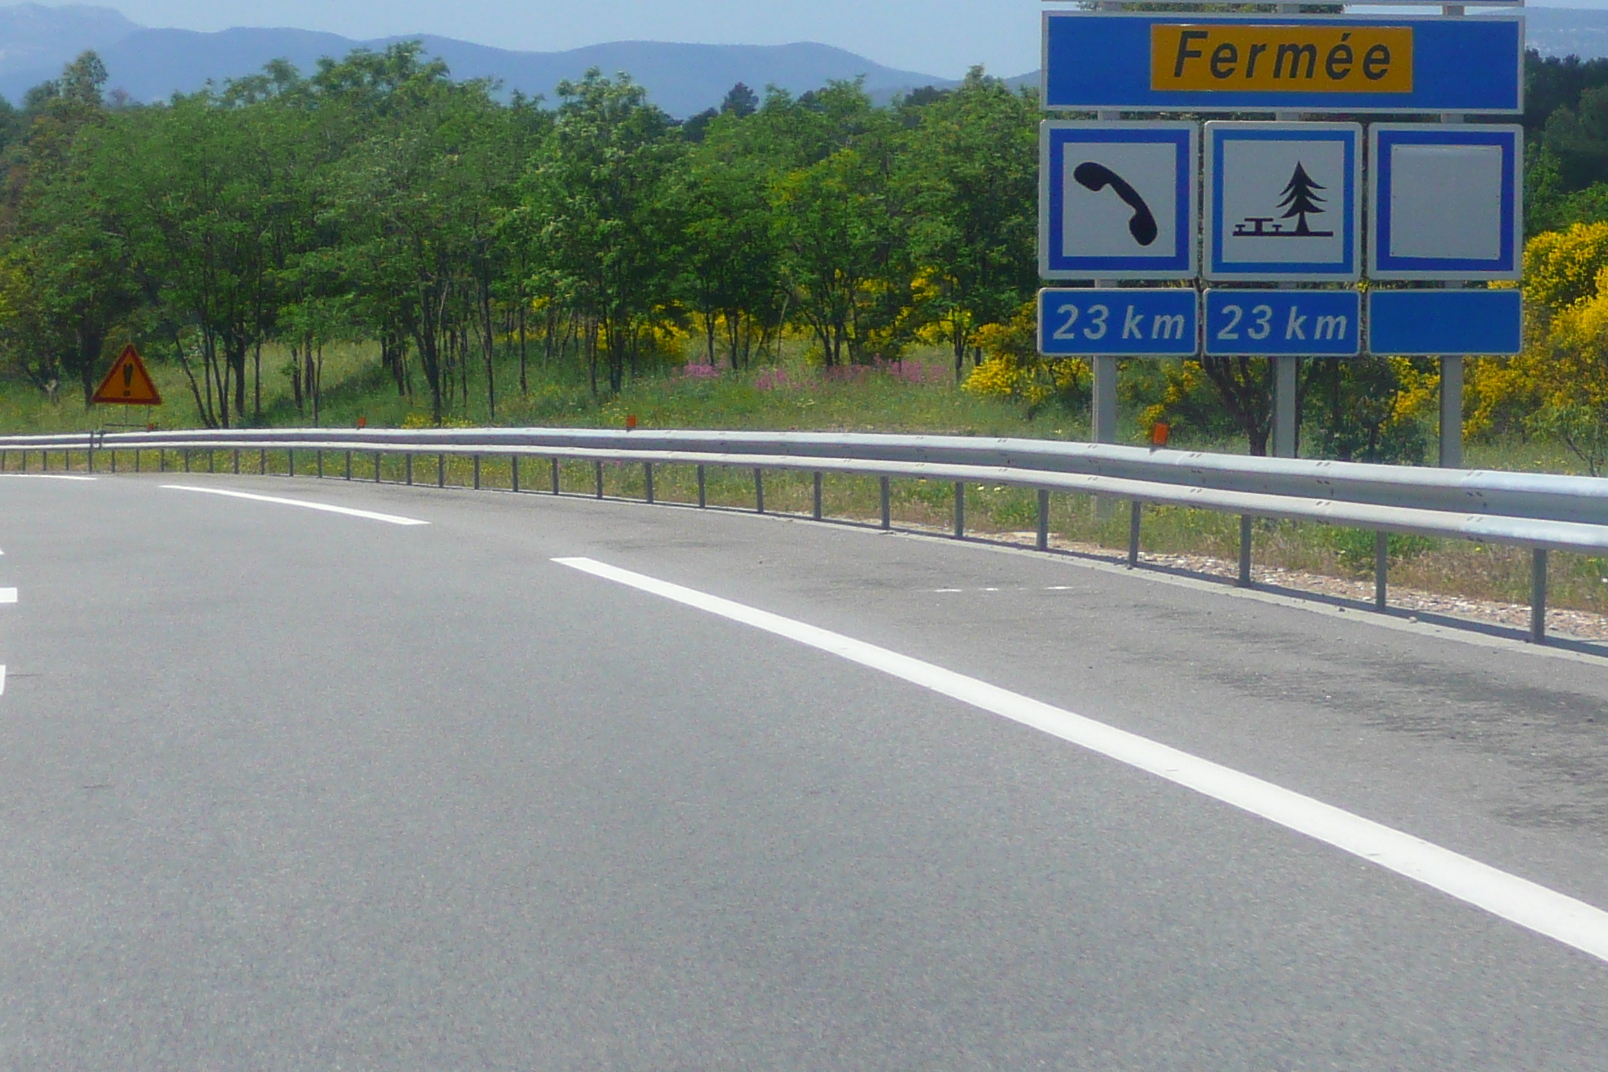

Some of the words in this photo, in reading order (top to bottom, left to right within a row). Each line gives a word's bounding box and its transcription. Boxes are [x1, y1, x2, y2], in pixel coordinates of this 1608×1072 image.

[1173, 29, 1391, 80] Fermée
[1052, 304, 1107, 340] 23
[1121, 305, 1185, 340] km
[1217, 305, 1271, 340] 23
[1286, 305, 1348, 340] km
